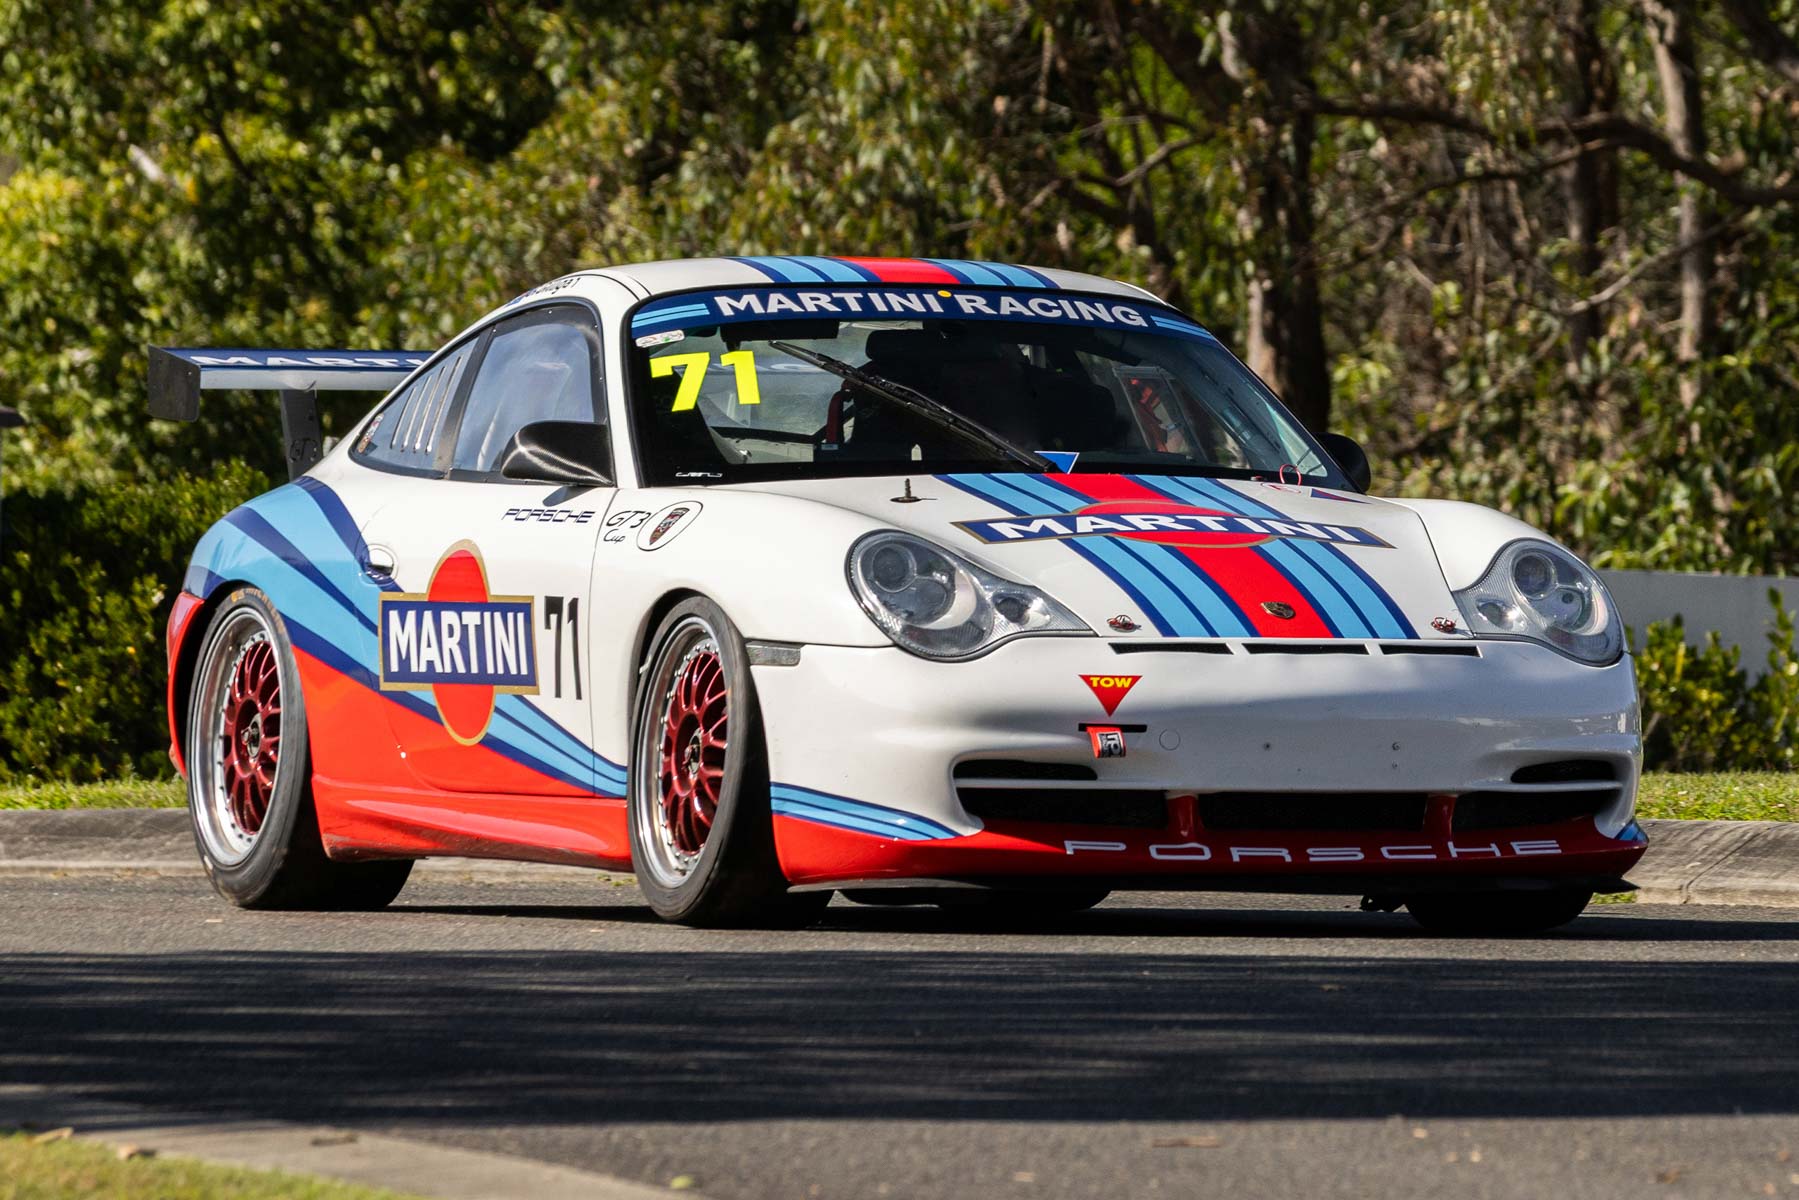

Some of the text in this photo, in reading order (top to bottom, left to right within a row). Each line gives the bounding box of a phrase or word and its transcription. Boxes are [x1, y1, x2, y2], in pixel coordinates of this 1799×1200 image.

[714, 292, 1148, 327] MARTINI RACING
[649, 350, 761, 412] 71
[501, 508, 595, 523] PORSCHE
[606, 510, 652, 528] GT3
[603, 528, 626, 544] Cup
[987, 515, 1361, 543] MARTINI
[388, 609, 529, 676] MARTINI
[544, 595, 582, 700] 71
[1090, 677, 1132, 687] TOW
[1064, 840, 1562, 863] PORSCHE
